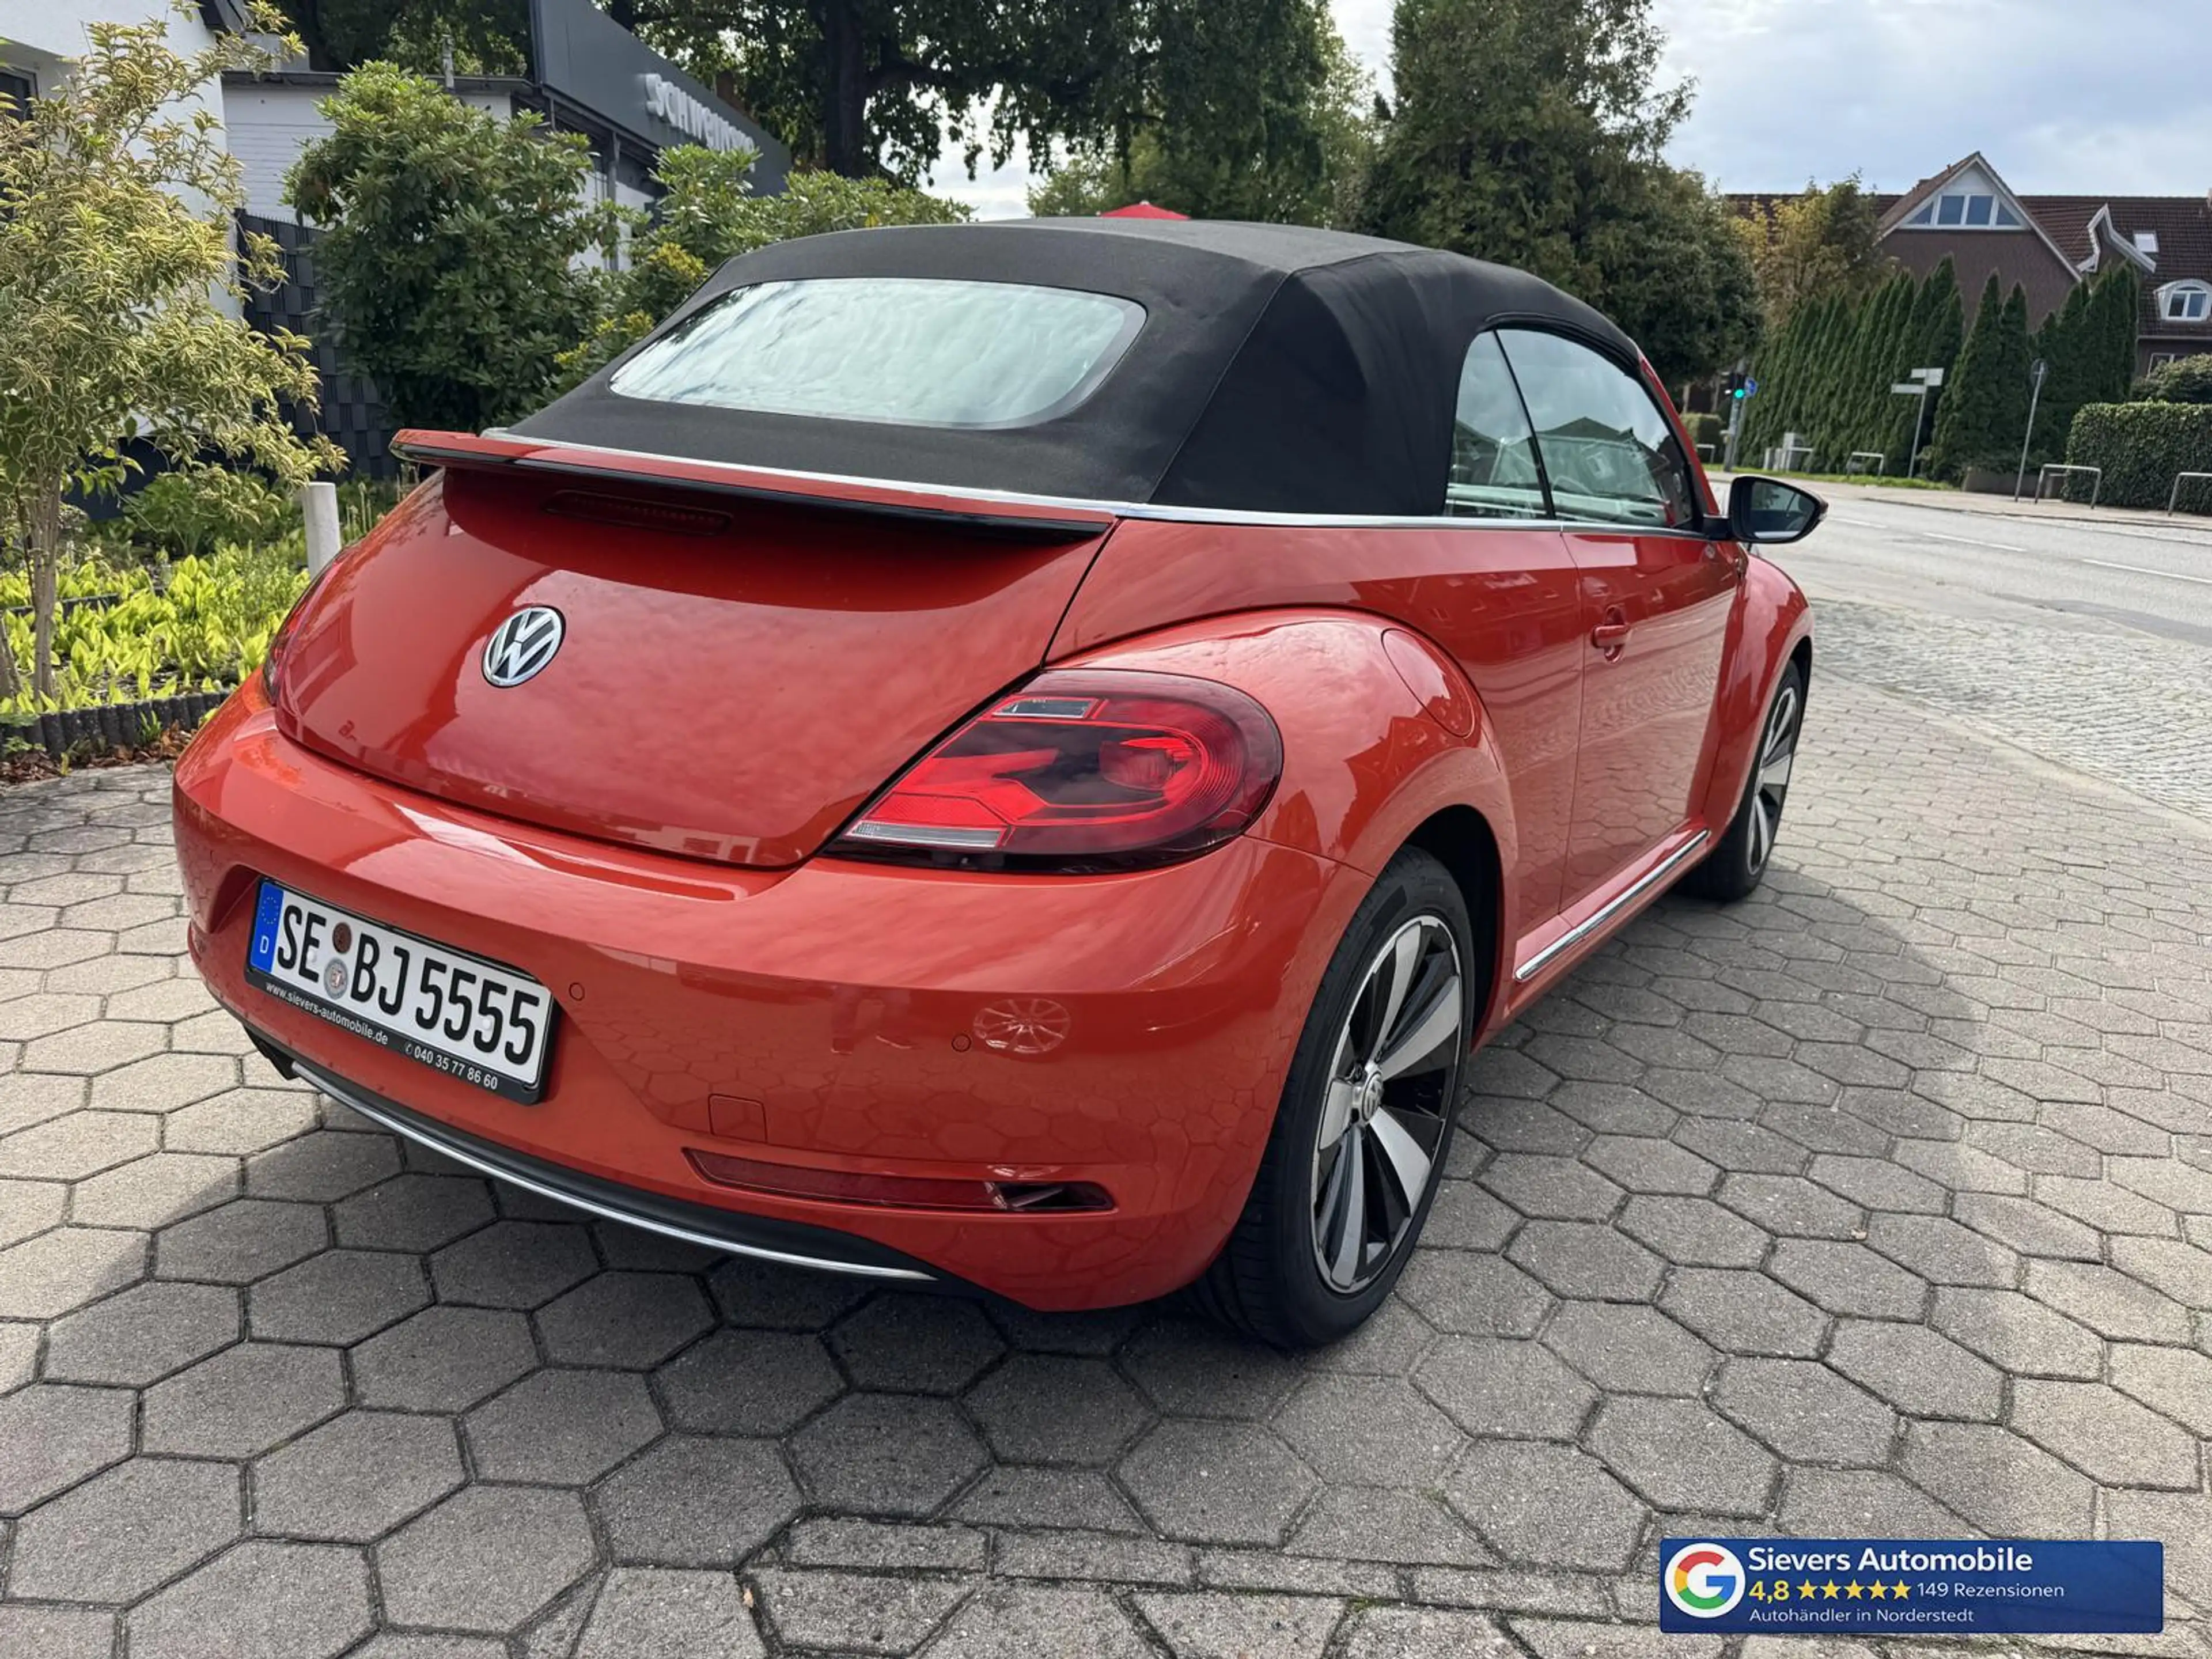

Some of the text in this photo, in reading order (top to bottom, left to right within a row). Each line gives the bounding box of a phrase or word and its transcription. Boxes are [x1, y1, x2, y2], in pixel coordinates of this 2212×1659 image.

[260, 935, 269, 954] D
[277, 904, 326, 983] SE
[350, 932, 410, 1016] BJ
[415, 957, 540, 1065] 5555
[265, 982, 388, 1046] www.sievers-automobile.de
[414, 1046, 498, 1090] 040 35 77 86 60
